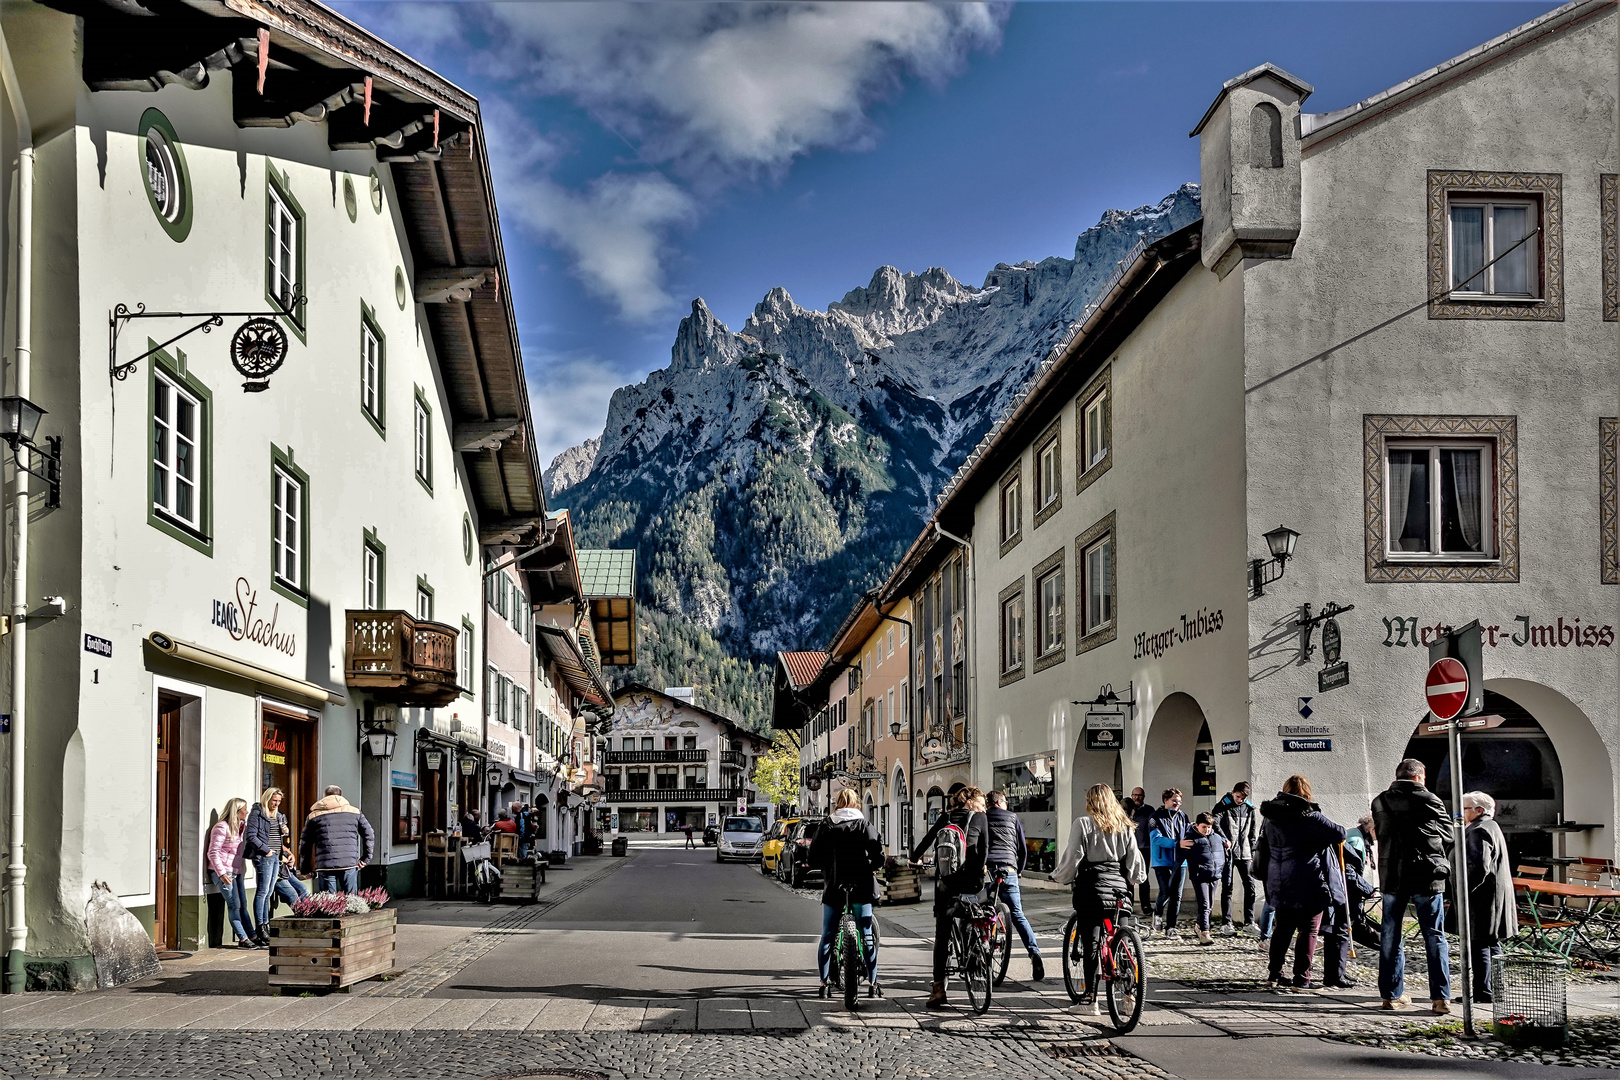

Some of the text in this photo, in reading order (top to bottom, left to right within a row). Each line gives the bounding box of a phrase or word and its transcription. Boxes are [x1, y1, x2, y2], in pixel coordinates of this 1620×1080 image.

[211, 598, 238, 633] JEANS
[227, 576, 296, 657] Stachus
[1382, 614, 1615, 648] Metr-Imbiss
[1133, 606, 1224, 660] Metzger-Imbiss
[93, 668, 100, 685] 1
[263, 725, 286, 753] tachus
[1288, 740, 1326, 749] Obermarkt
